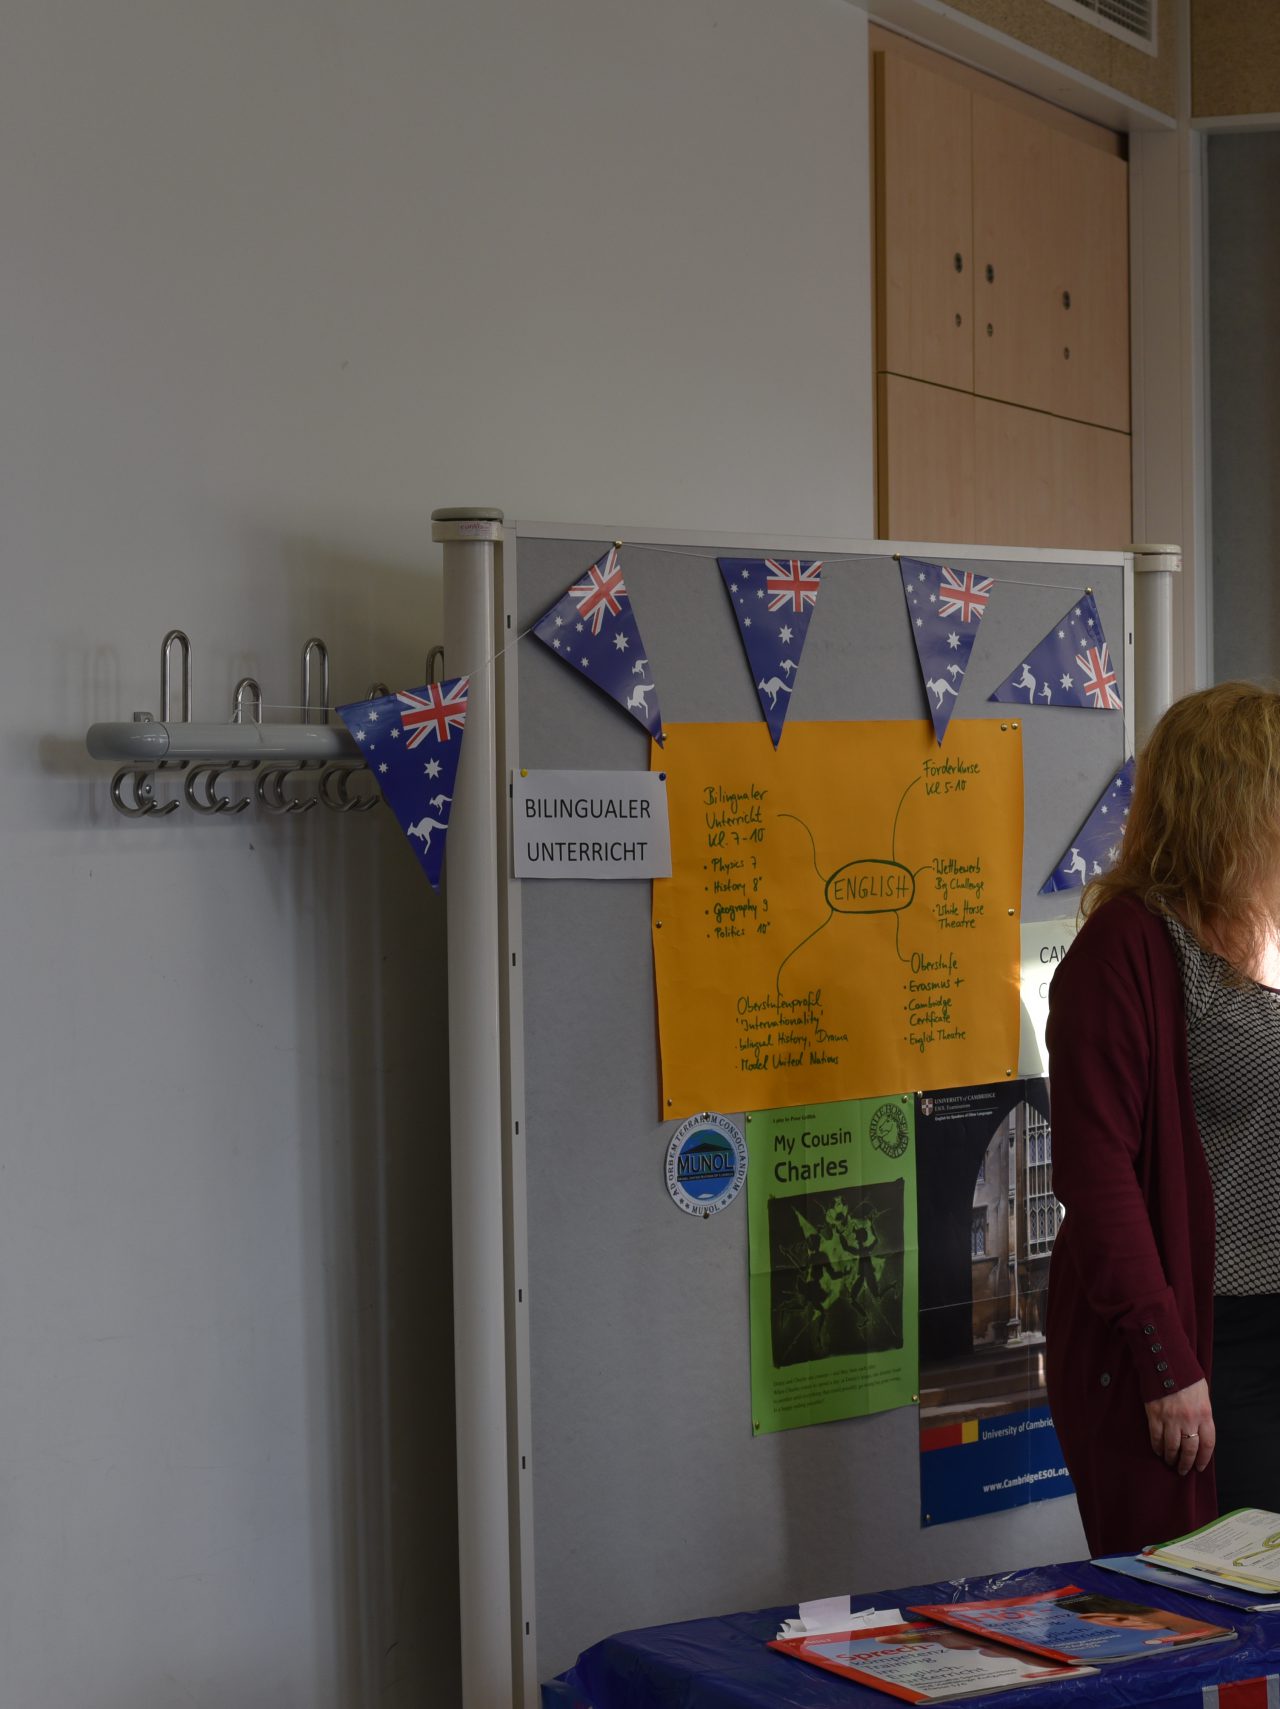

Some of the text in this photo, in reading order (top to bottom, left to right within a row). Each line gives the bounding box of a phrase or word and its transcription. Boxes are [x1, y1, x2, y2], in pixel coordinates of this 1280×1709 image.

[525, 799, 652, 819] BILINGUALER
[704, 784, 768, 814] Bilingualer
[706, 806, 763, 830] Unterricht
[527, 842, 648, 862] UNTERRICHT
[711, 858, 745, 875] Physics
[714, 880, 746, 896] History
[834, 876, 910, 901] ENGLISH
[713, 898, 758, 923] Geography
[714, 926, 745, 939] Politics
[938, 917, 977, 929] Theatre
[911, 952, 959, 975] Oberstufe
[908, 978, 951, 993] Erasmus
[908, 995, 953, 1014] Cambridge
[775, 1129, 852, 1155] My Cousin
[678, 1151, 735, 1177] MUNOL
[775, 1157, 848, 1183] Charles
[982, 1425, 1017, 1441] University
[1018, 1422, 1026, 1434] of
[837, 1643, 934, 1662] Sprech-
